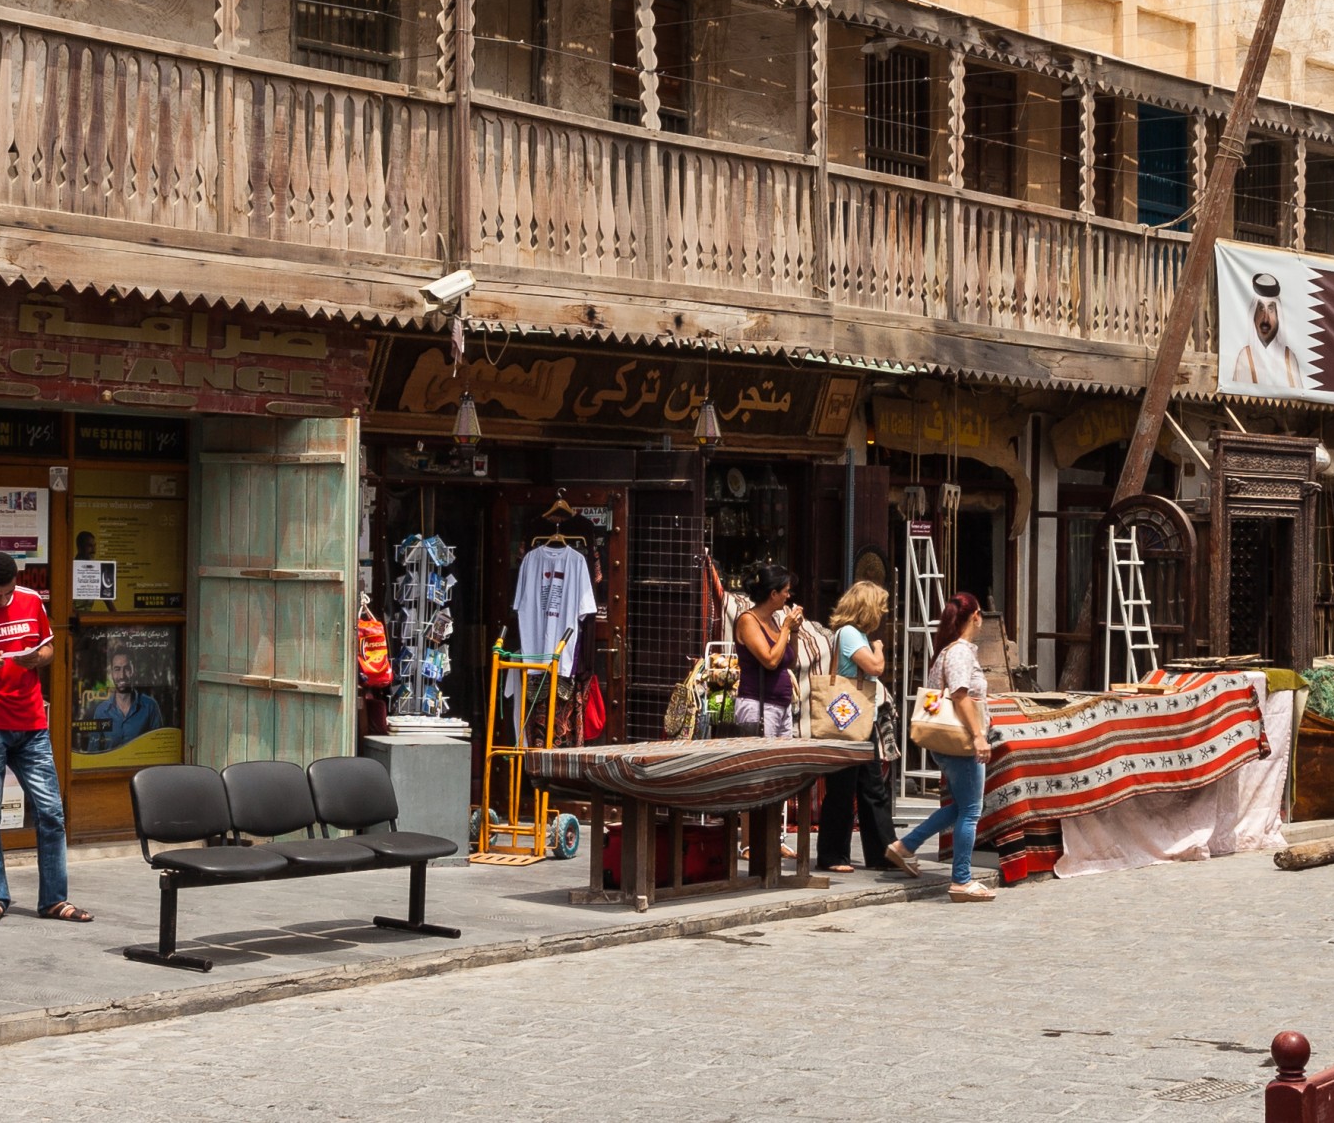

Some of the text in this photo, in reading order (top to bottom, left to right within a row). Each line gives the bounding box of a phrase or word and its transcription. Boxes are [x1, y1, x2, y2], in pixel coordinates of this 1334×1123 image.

[18, 291, 327, 360] صرافة
[573, 360, 661, 424] تركي
[663, 381, 710, 421] بن
[718, 381, 791, 423] متجر
[80, 428, 144, 441] WESTERN
[99, 440, 144, 452] UNION
